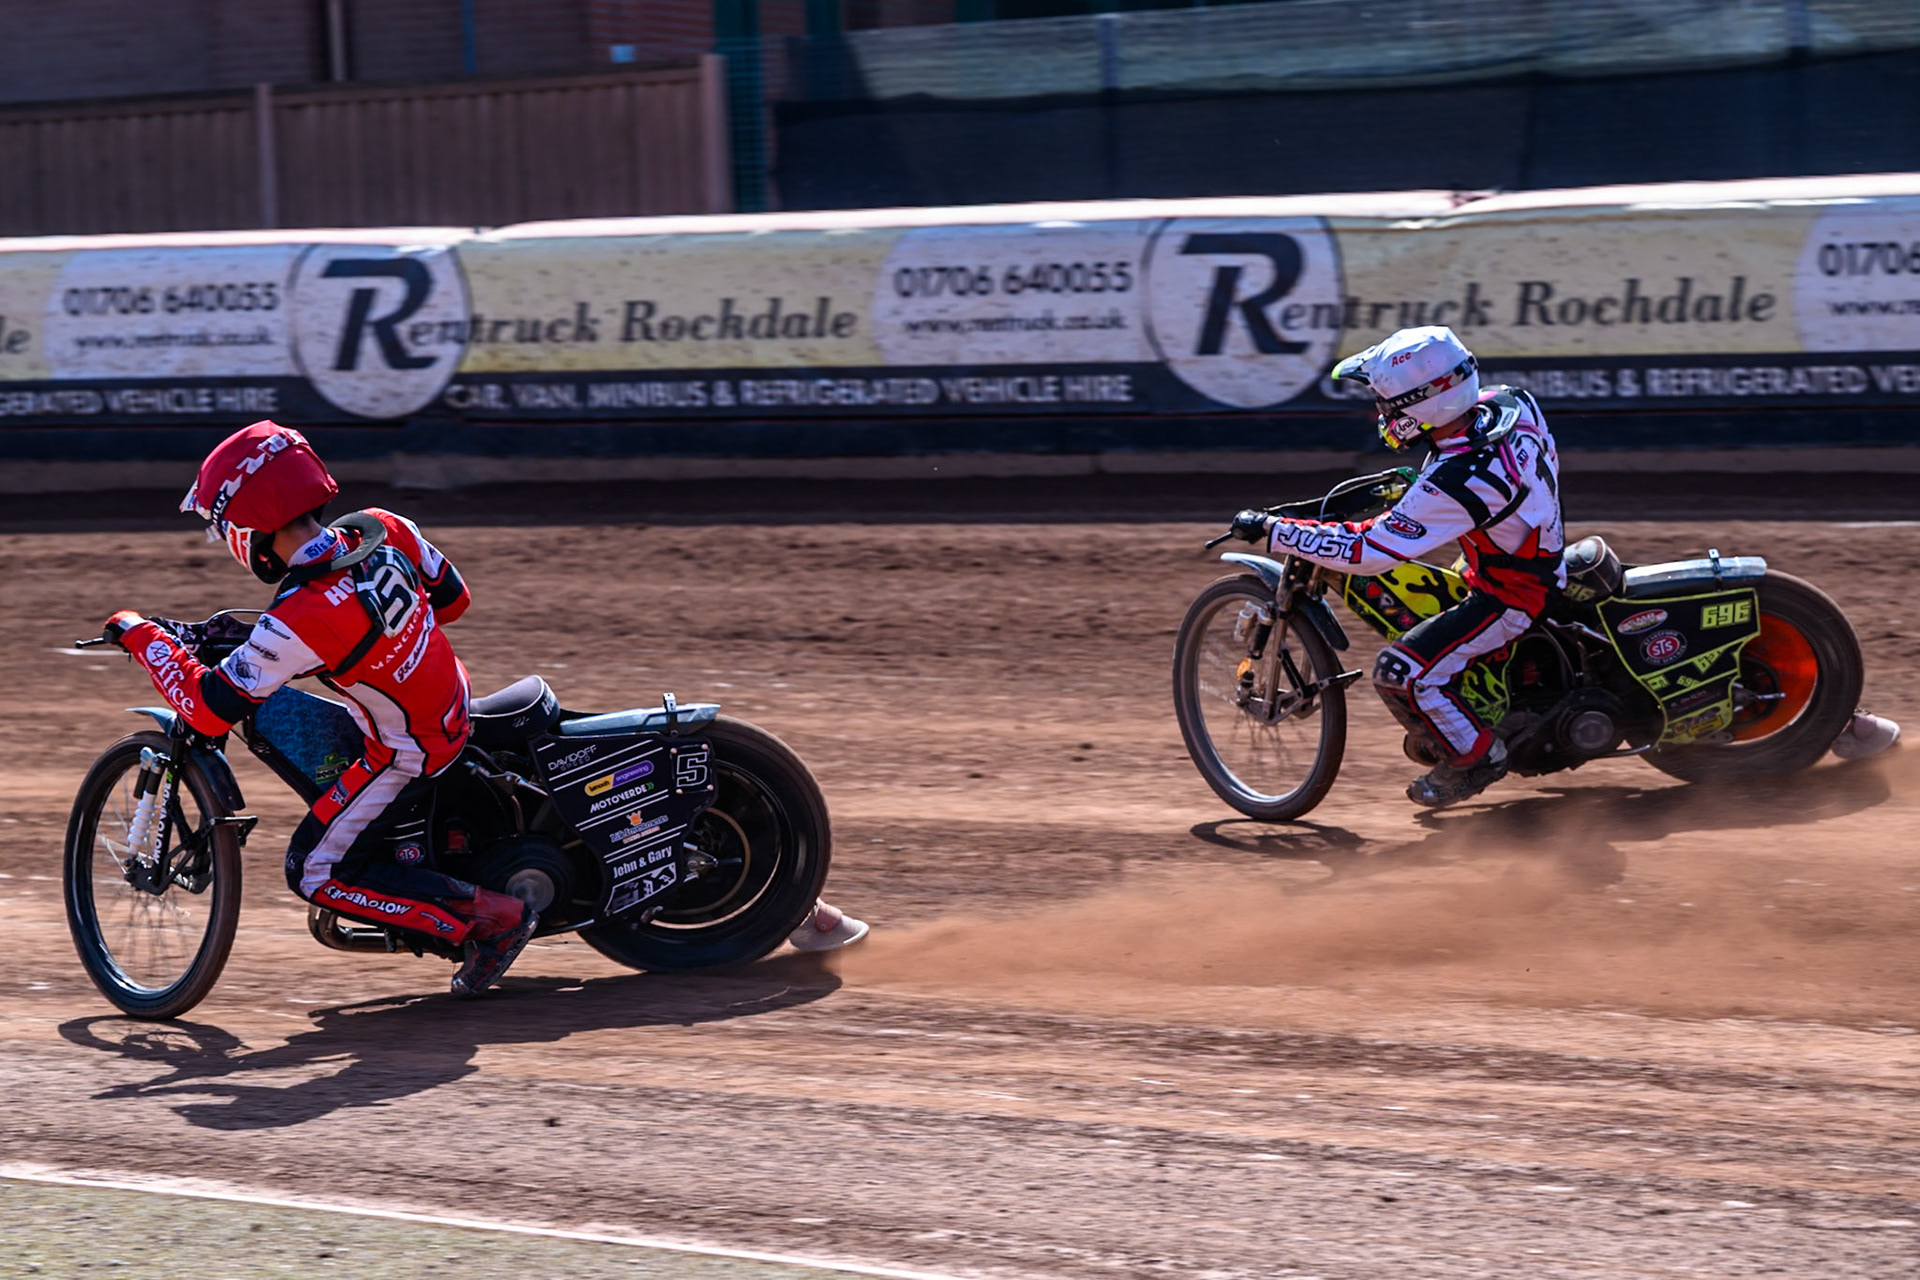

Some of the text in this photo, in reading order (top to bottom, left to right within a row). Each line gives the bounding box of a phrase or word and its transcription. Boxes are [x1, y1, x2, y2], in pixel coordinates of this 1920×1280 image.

[894, 261, 1133, 298] 01706 640055
[63, 281, 280, 317] 01706 640055
[1512, 275, 1777, 327] Rochdale
[618, 296, 859, 343] Rochdale
[587, 380, 706, 407] MINIBUS
[712, 379, 736, 406] &
[740, 375, 939, 406] REFRIGERATED
[940, 375, 1062, 404] VEHICLE
[1065, 375, 1133, 402] HIRE
[1646, 365, 1869, 397] REFRIGERATED
[104, 389, 215, 413] VEHICLE
[216, 387, 279, 412] HIRE
[375, 567, 413, 631] 5
[1701, 600, 1752, 630] 696
[1652, 639, 1673, 656] STS
[548, 744, 597, 771] DAVIDOFF
[676, 751, 708, 788] 5
[590, 783, 648, 814] MOTOVERDE
[613, 845, 673, 879] John & Gary
